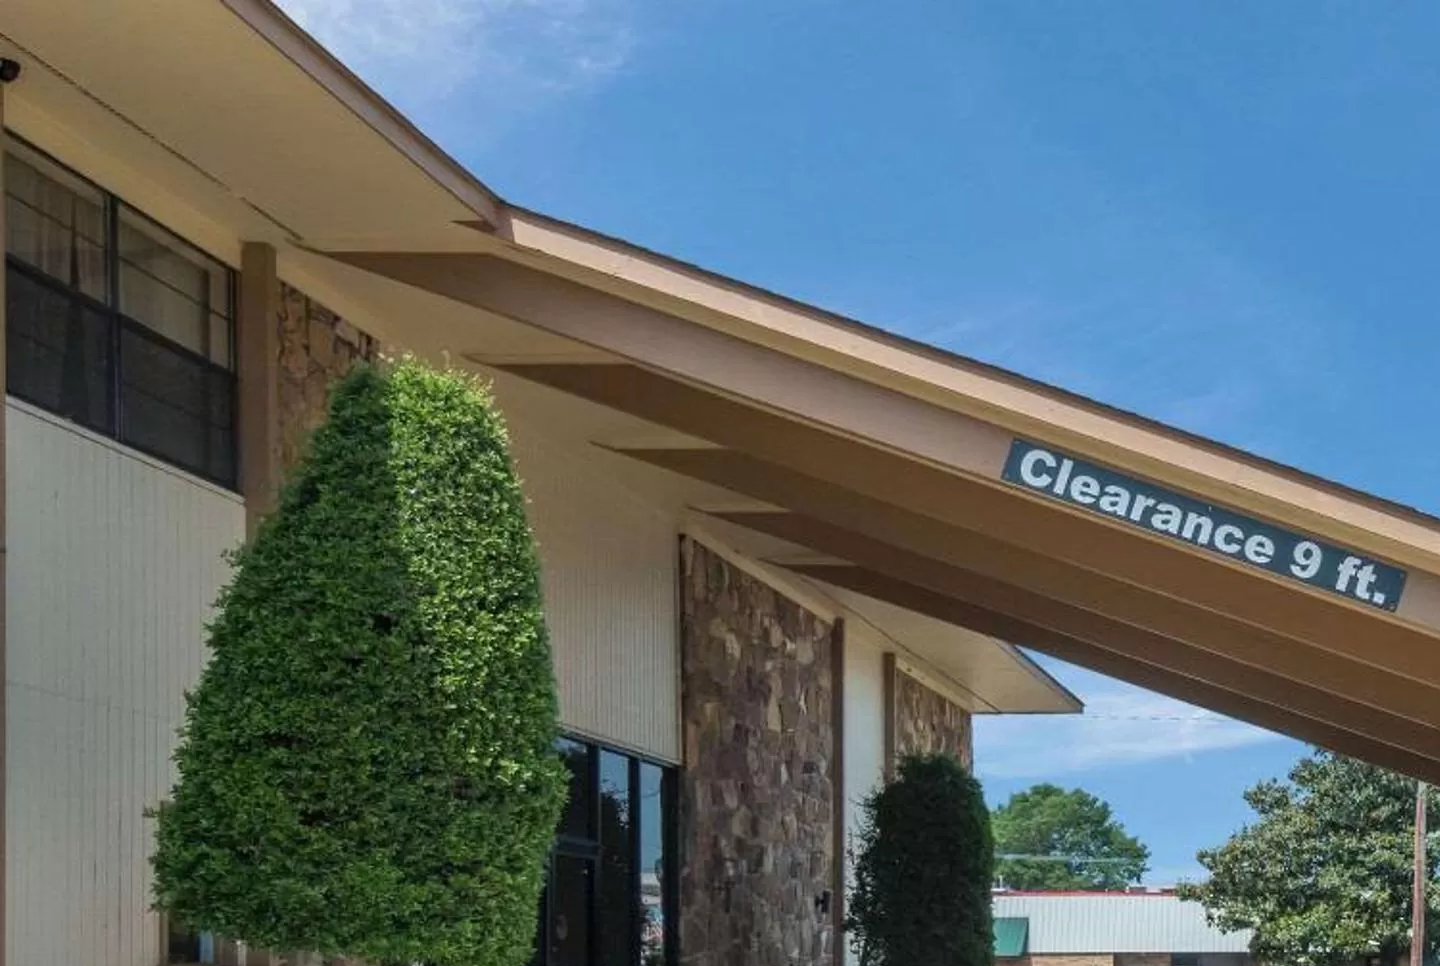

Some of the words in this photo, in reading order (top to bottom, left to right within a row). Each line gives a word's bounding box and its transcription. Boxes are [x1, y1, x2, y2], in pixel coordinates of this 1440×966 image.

[1019, 448, 1275, 564] Clearance
[1289, 541, 1323, 579] 9
[1333, 555, 1386, 605] ft.
